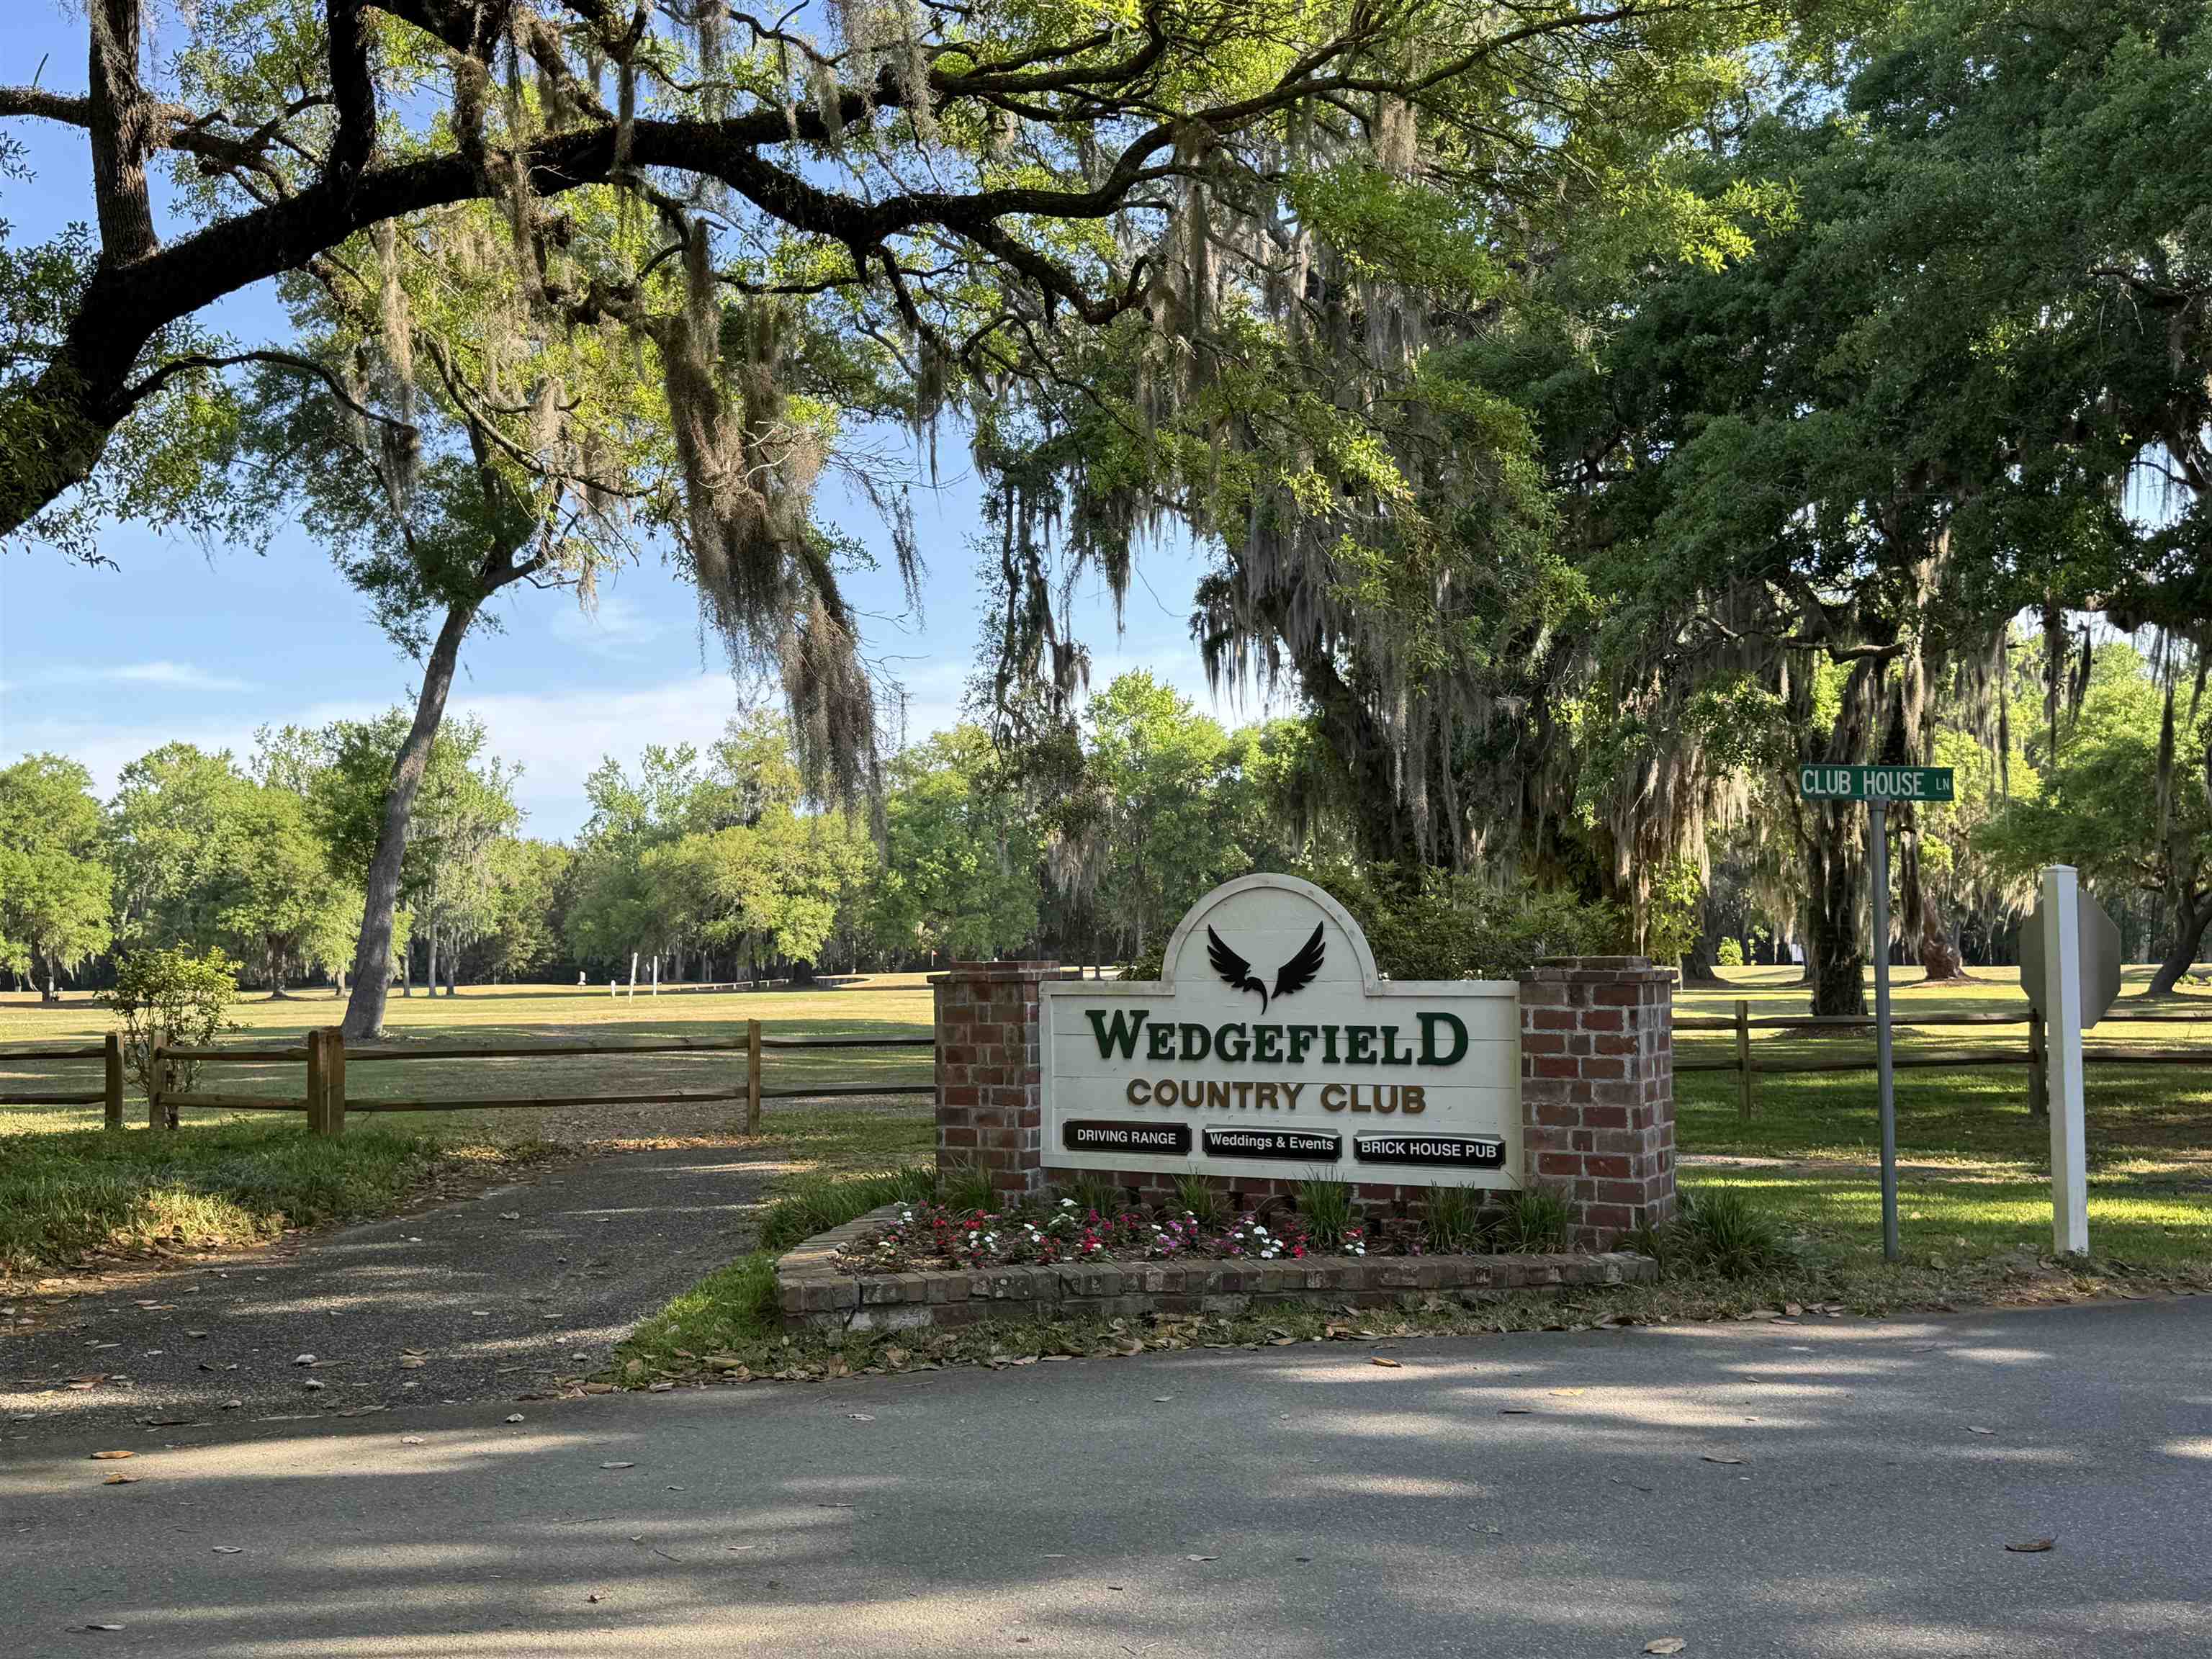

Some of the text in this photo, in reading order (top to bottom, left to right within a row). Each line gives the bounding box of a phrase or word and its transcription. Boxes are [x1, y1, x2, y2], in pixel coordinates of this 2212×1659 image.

[1802, 769, 1950, 796] CLUB HOUSE LN
[1085, 1009, 1469, 1066] WEDGEFIELD
[1126, 1078, 1426, 1113] COUNTRY CLUB
[1077, 1128, 1177, 1145] DRIVING RANGE
[1210, 1133, 1334, 1151] Weddings & Events
[1361, 1141, 1498, 1159] BRICK HOUSE PUB
